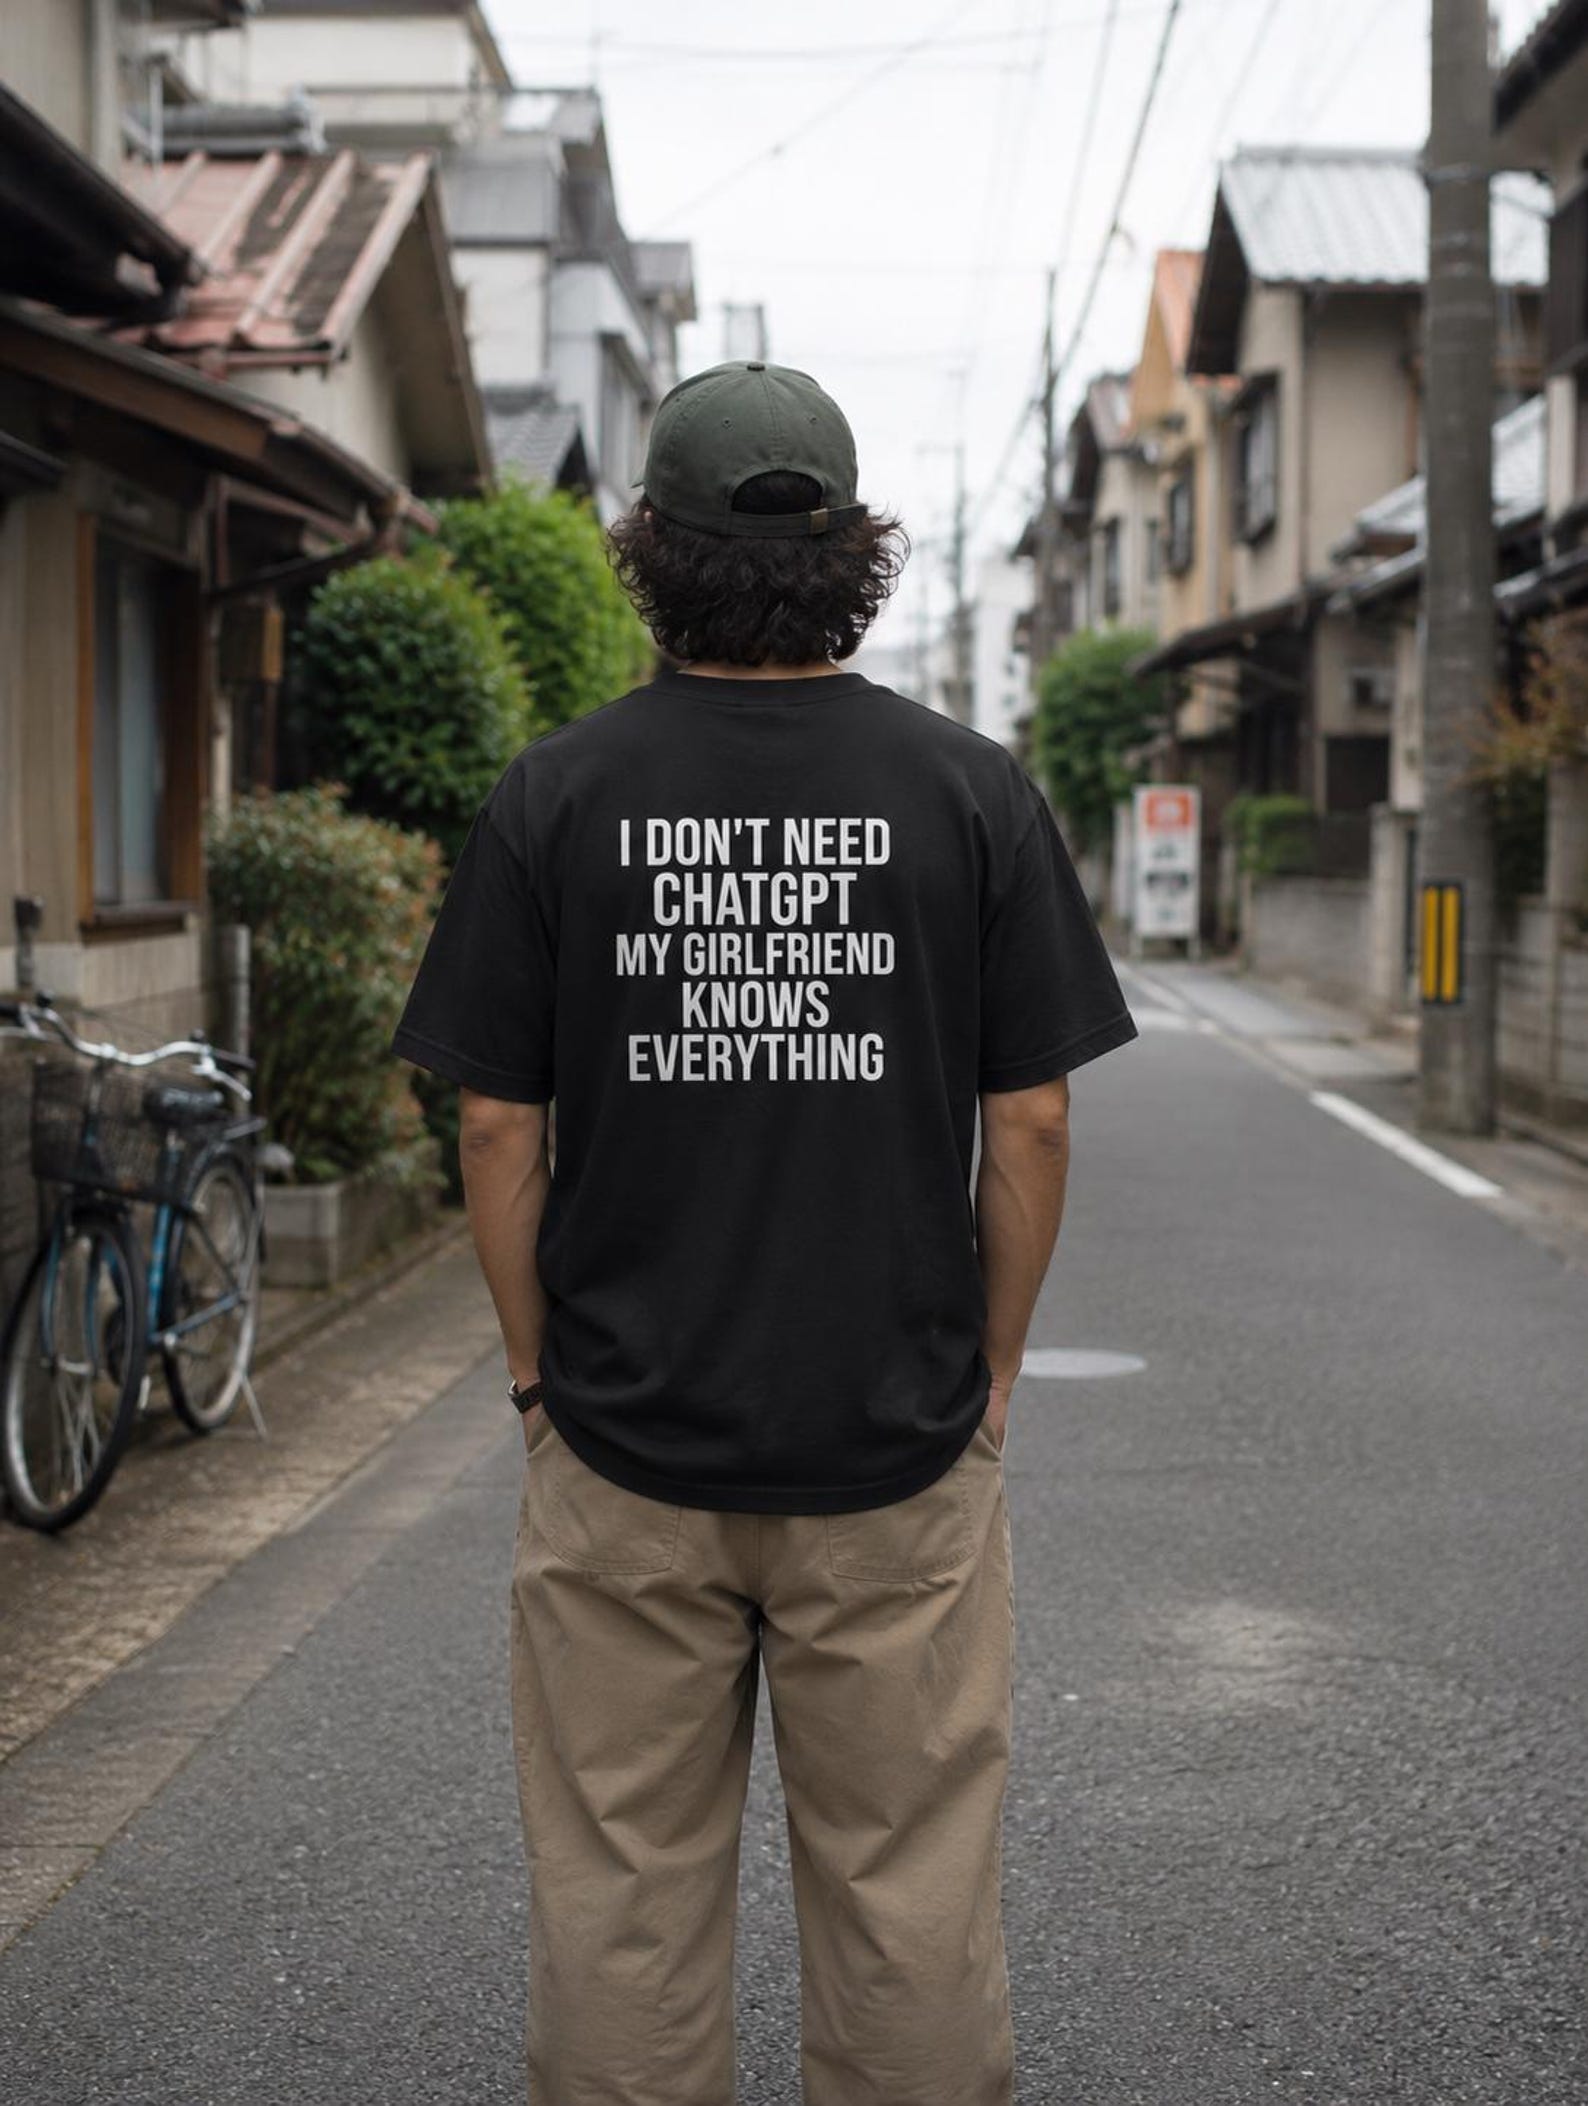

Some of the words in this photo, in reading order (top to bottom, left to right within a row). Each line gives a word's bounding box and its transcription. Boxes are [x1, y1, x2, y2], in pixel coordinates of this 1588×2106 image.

[620, 818, 631, 867] I
[646, 817, 771, 866] DON'T
[783, 817, 891, 866] NEED
[653, 871, 858, 927] CHATGPT
[616, 932, 672, 976] MY
[683, 932, 896, 976] GIRLFRIEND
[682, 980, 830, 1028] KNOWS
[628, 1032, 885, 1082] EVERYTHING
